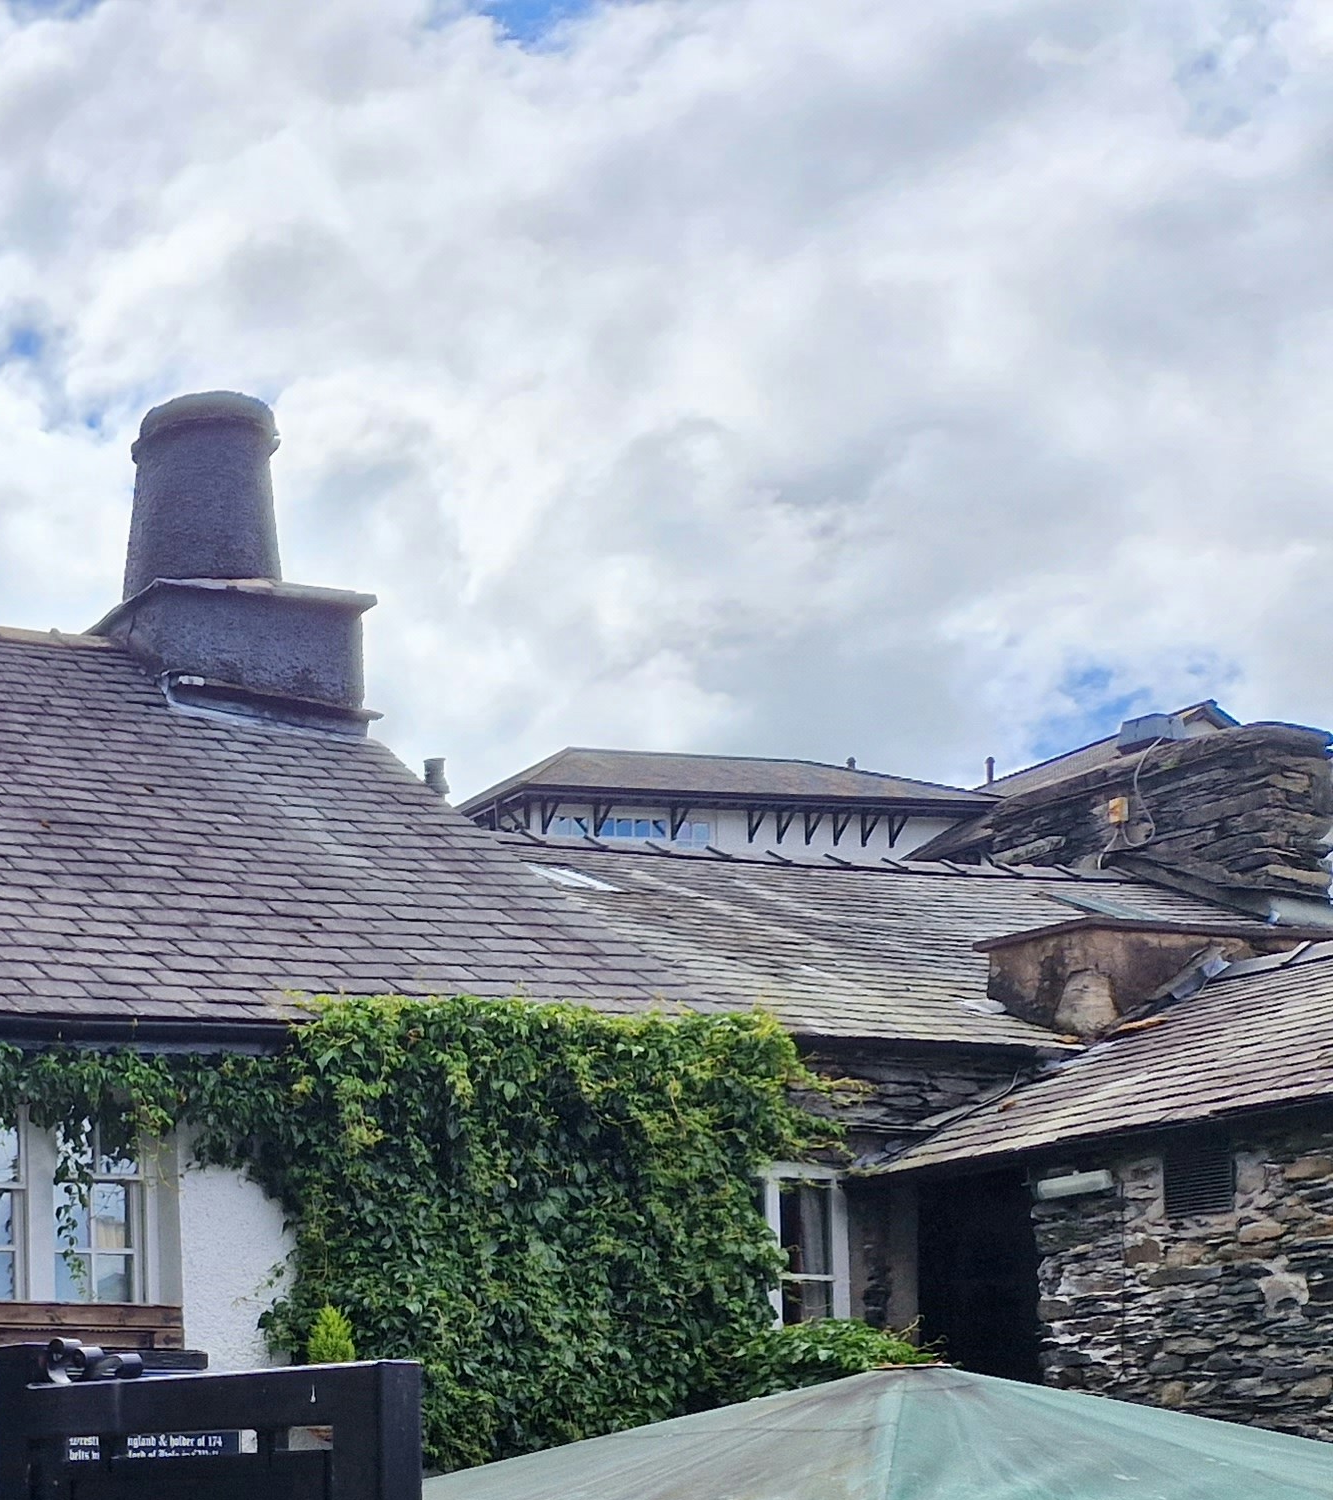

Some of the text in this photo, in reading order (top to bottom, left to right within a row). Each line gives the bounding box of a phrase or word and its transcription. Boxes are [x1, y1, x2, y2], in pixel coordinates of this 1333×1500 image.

[126, 1435, 156, 1449] ngland
[158, 1433, 168, 1447] &
[169, 1434, 195, 1448] holder
[197, 1434, 206, 1447] of
